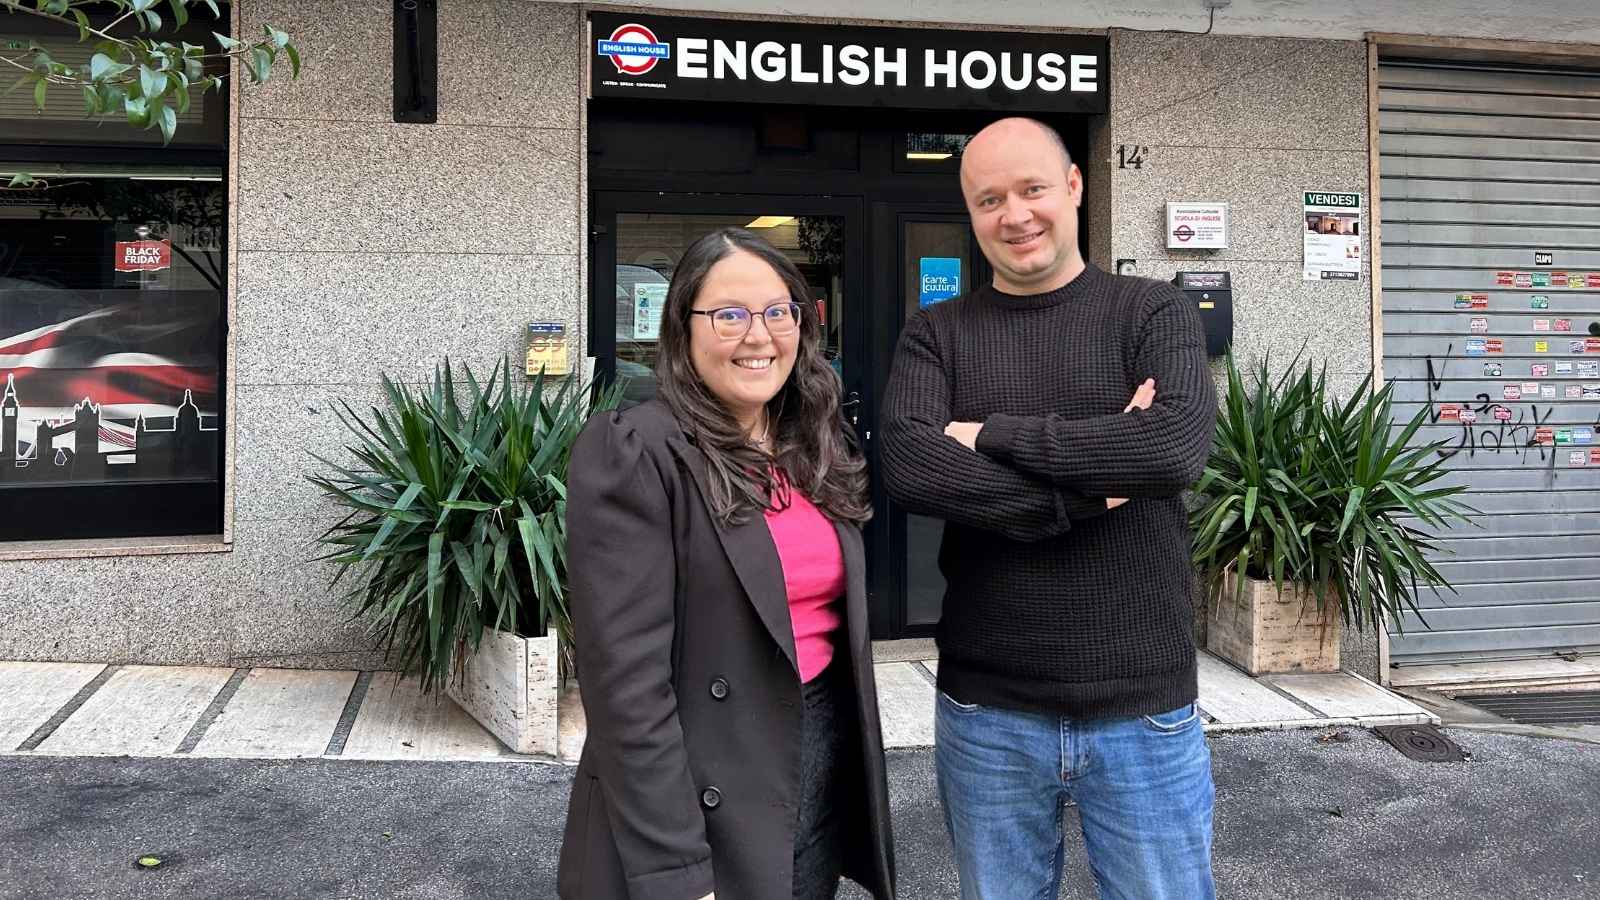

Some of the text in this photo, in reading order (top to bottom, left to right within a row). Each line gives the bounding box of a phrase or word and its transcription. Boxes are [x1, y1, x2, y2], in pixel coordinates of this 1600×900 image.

[602, 44, 666, 55] ENGLISH HOUSE
[676, 37, 1098, 93] ENGLISH HOUSE
[1308, 193, 1356, 206] VENDESI
[126, 247, 161, 256] BLACK
[124, 255, 162, 264] FRIDAY
[925, 276, 949, 284] carte
[925, 284, 956, 292] cultura
